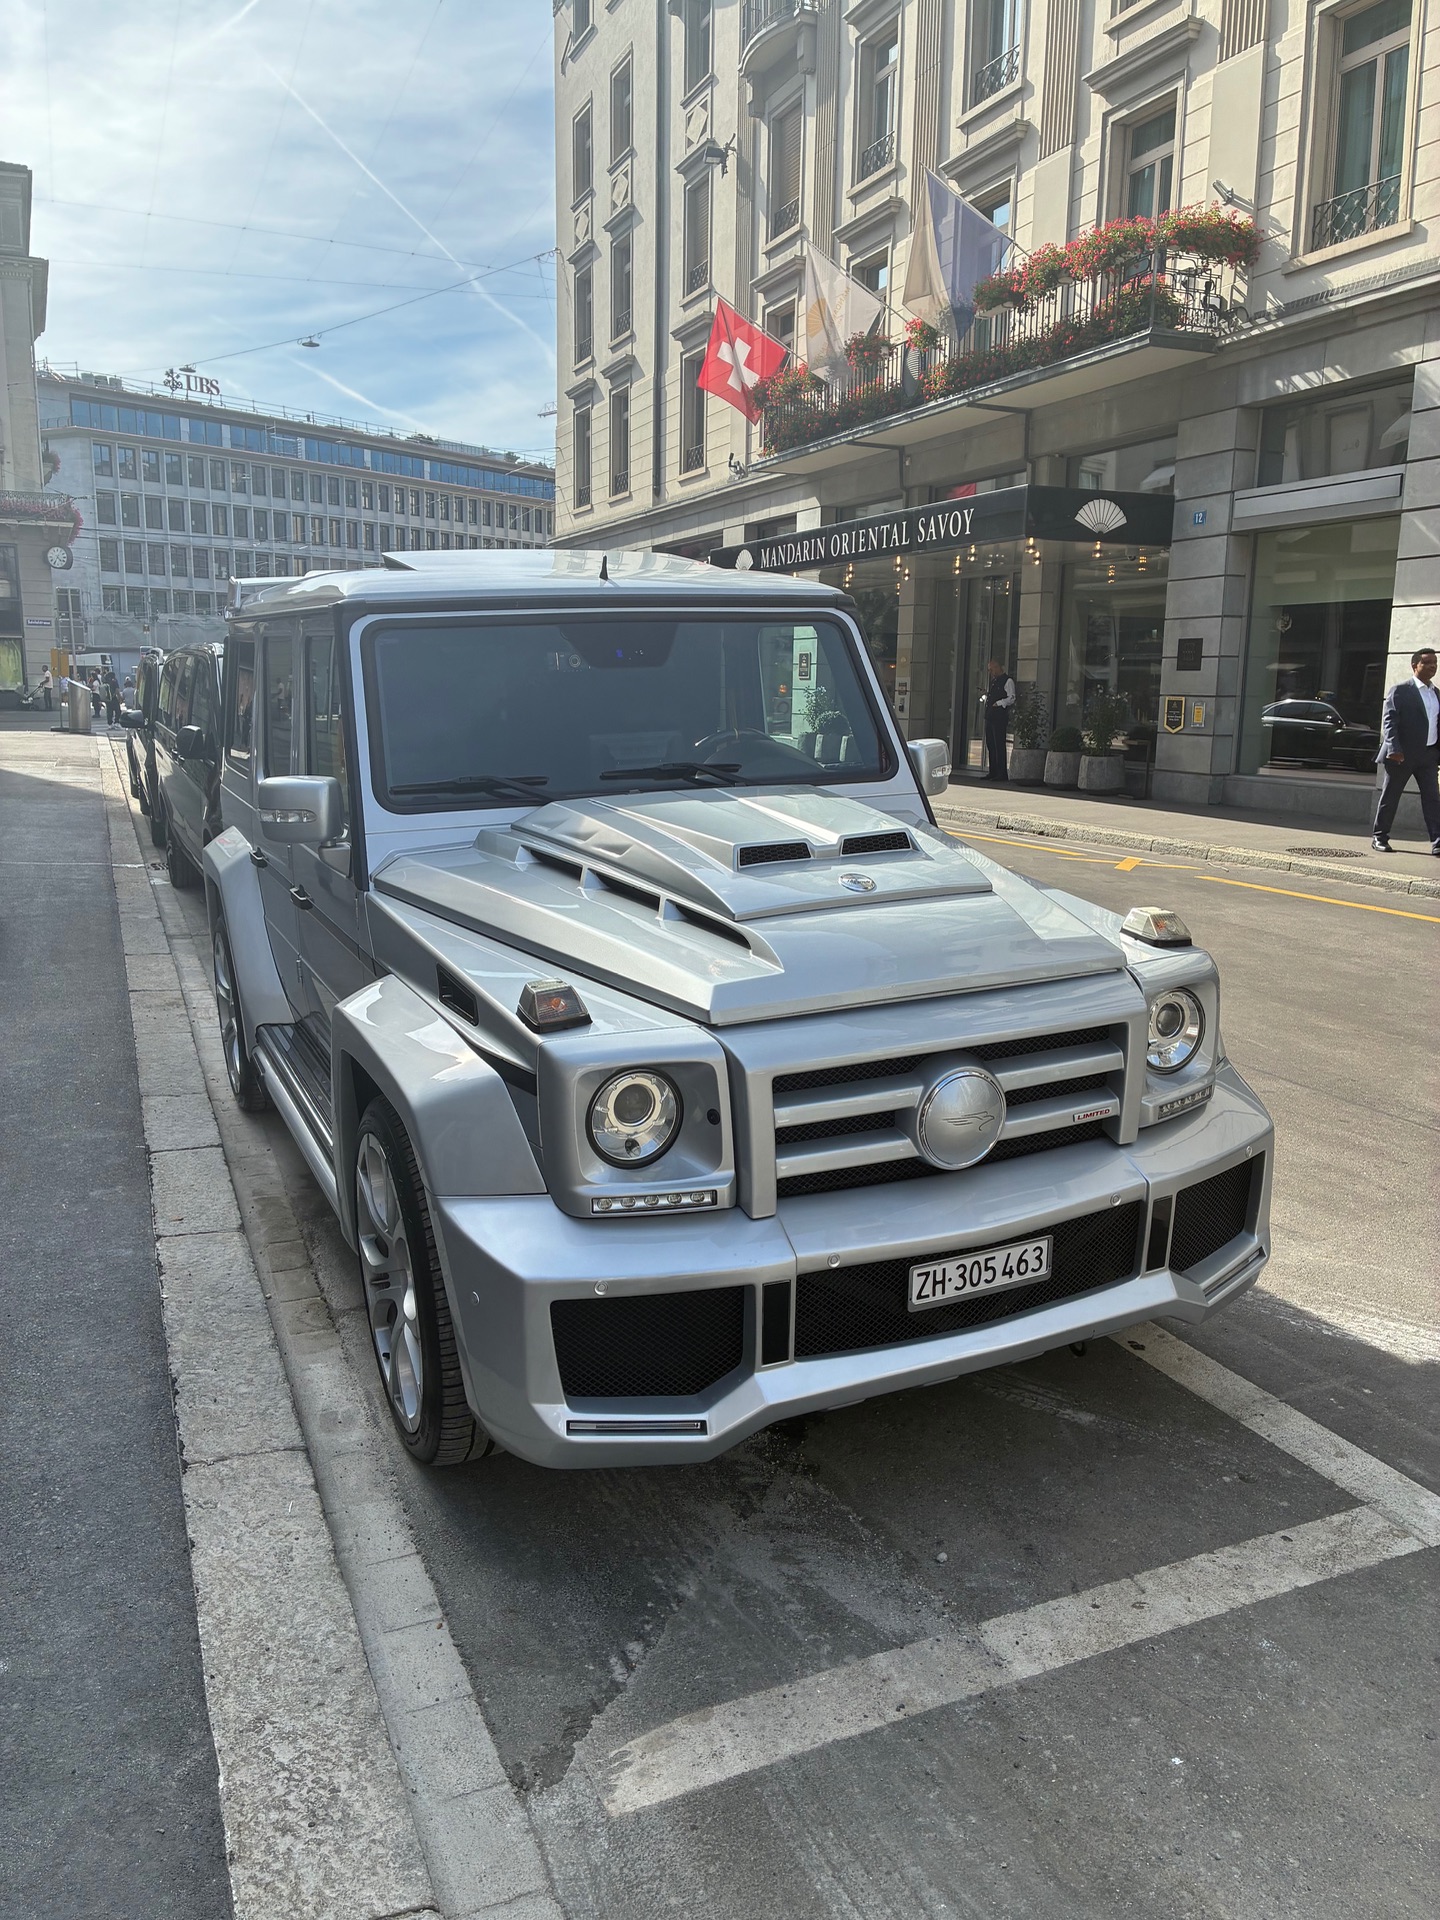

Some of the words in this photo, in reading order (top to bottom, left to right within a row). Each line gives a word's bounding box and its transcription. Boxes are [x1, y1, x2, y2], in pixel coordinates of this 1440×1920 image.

[185, 374, 220, 396] UBS
[1195, 512, 1203, 524] 12
[760, 536, 826, 569] MANDARIN
[830, 521, 910, 557] ORIENTAL
[917, 508, 975, 543] SAVOY
[1077, 1108, 1110, 1120] LIMITED
